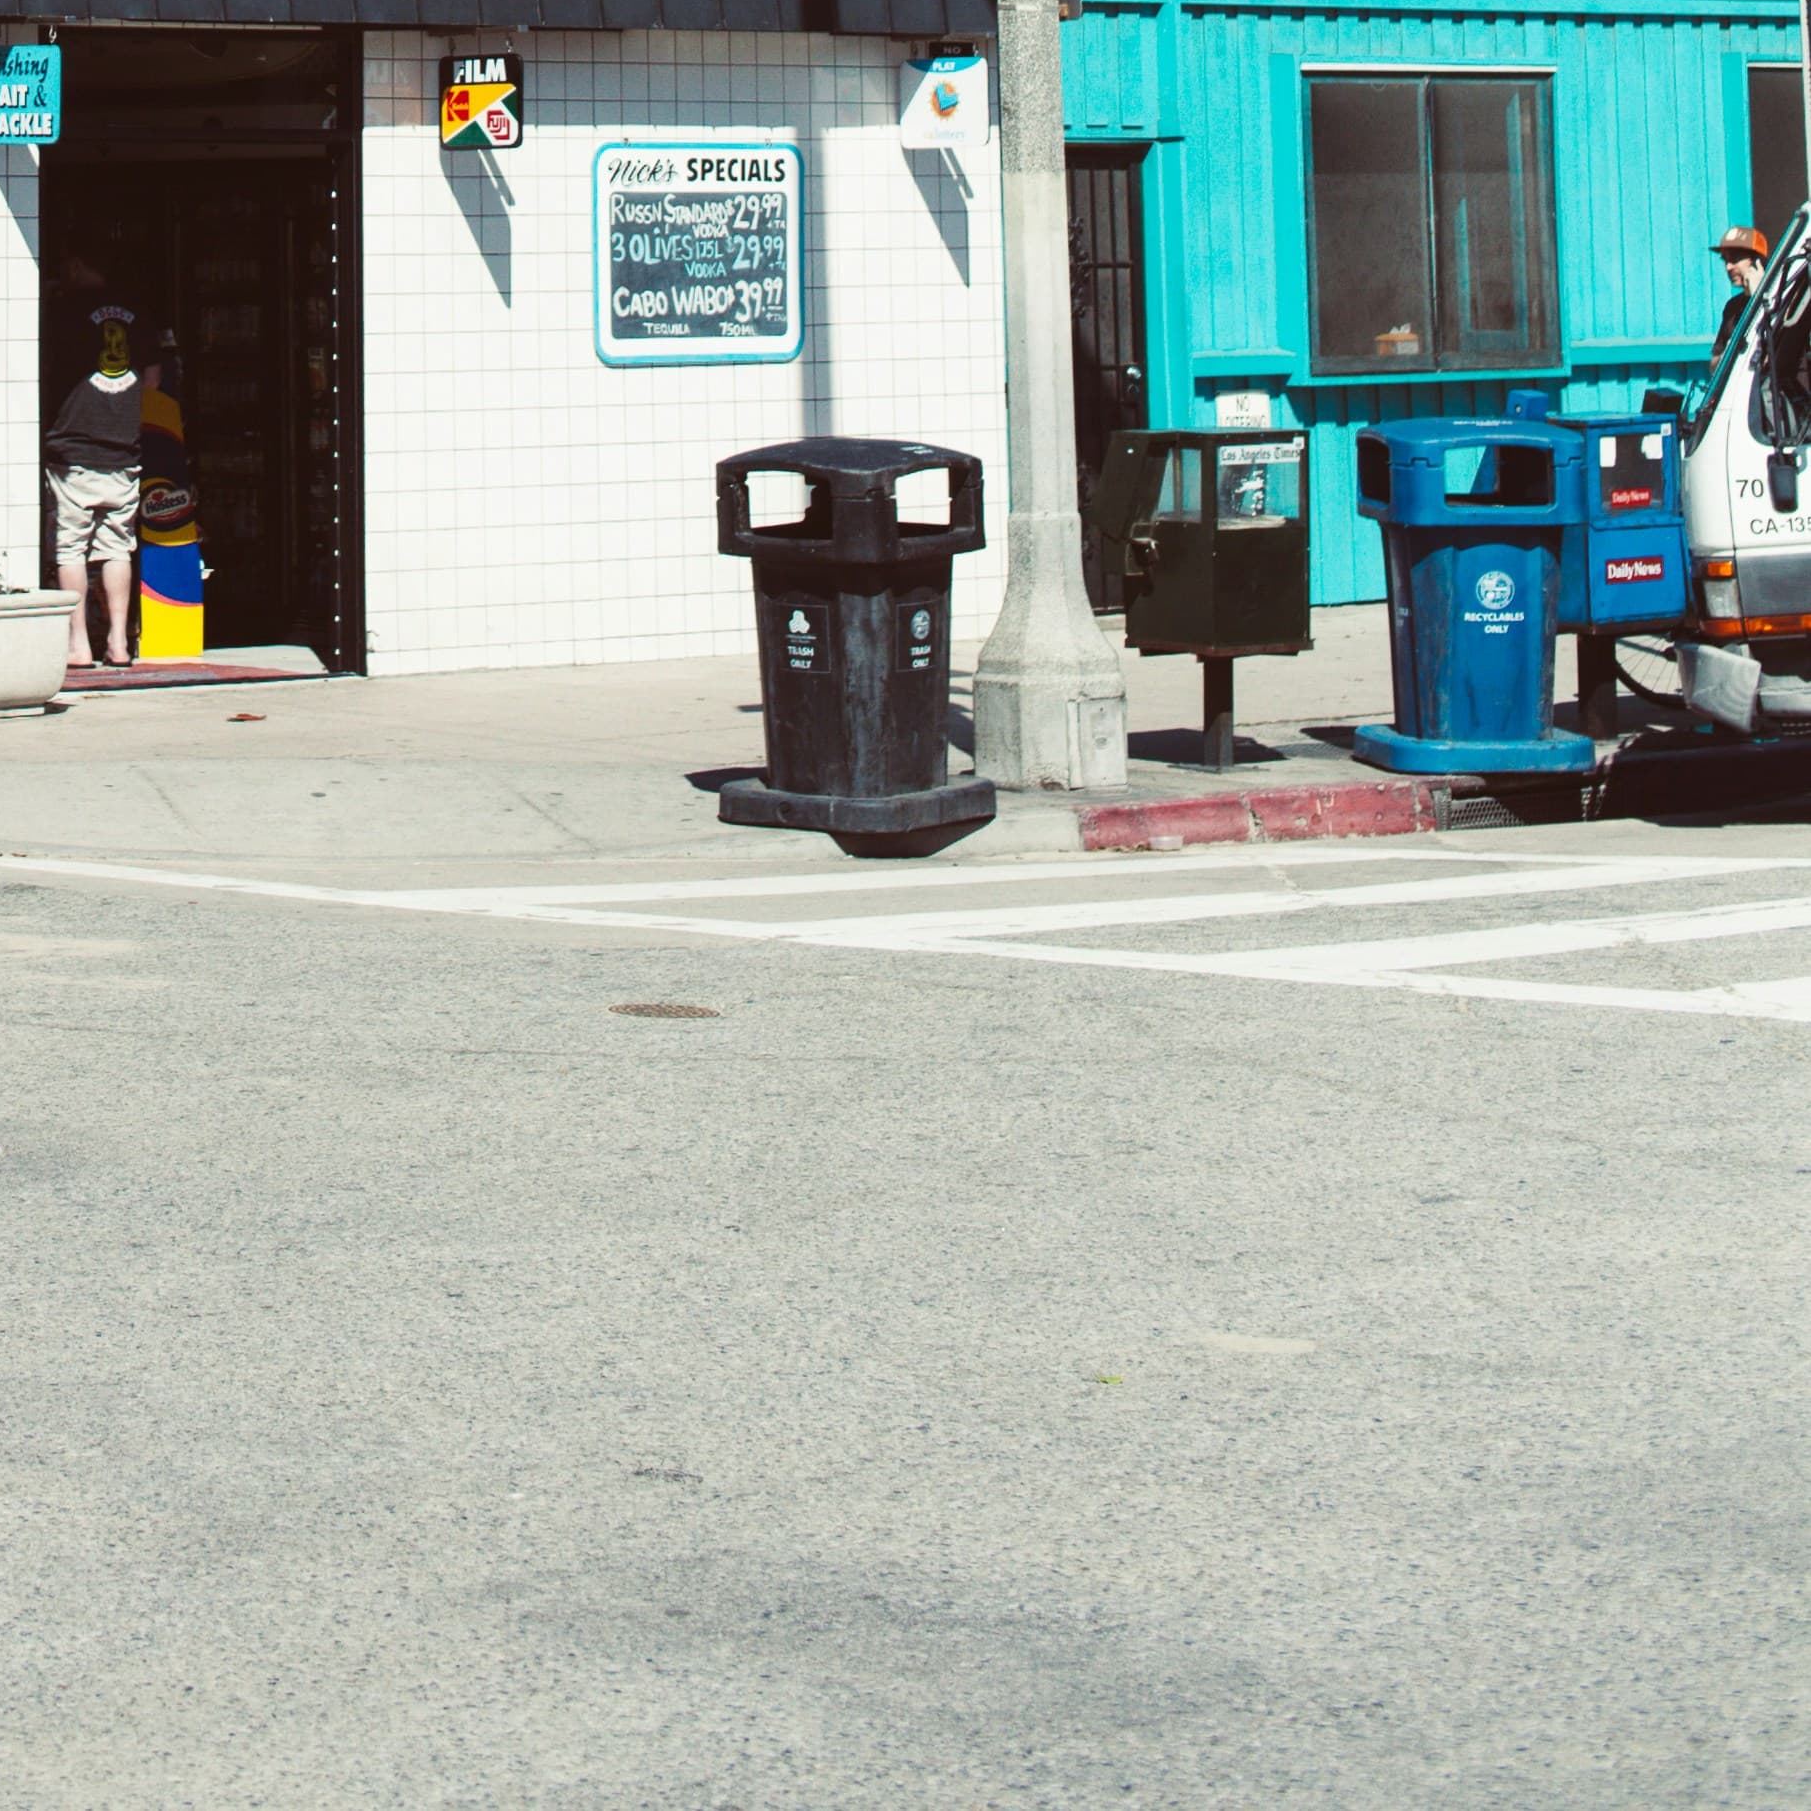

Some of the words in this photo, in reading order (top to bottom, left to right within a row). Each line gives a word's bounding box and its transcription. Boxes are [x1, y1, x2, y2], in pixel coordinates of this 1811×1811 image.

[453, 58, 508, 83] FILM
[33, 84, 48, 107] &
[608, 158, 678, 187] Nick's
[687, 158, 786, 183] SPECIALS
[611, 232, 626, 262] 3
[685, 262, 727, 278] VODKA
[613, 285, 669, 318] CABO
[671, 284, 729, 316] WABO
[642, 322, 691, 335] TEQUILA
[1236, 395, 1250, 412] NO
[1221, 447, 1236, 461] Los
[1239, 448, 1271, 462] Angeles
[1274, 446, 1301, 460] Times
[1736, 478, 1765, 498] 70
[1464, 612, 1525, 622] RECYCLABLES
[1484, 624, 1509, 634] ONLY
[787, 645, 815, 657] TRASH
[790, 658, 813, 669] ONLY
